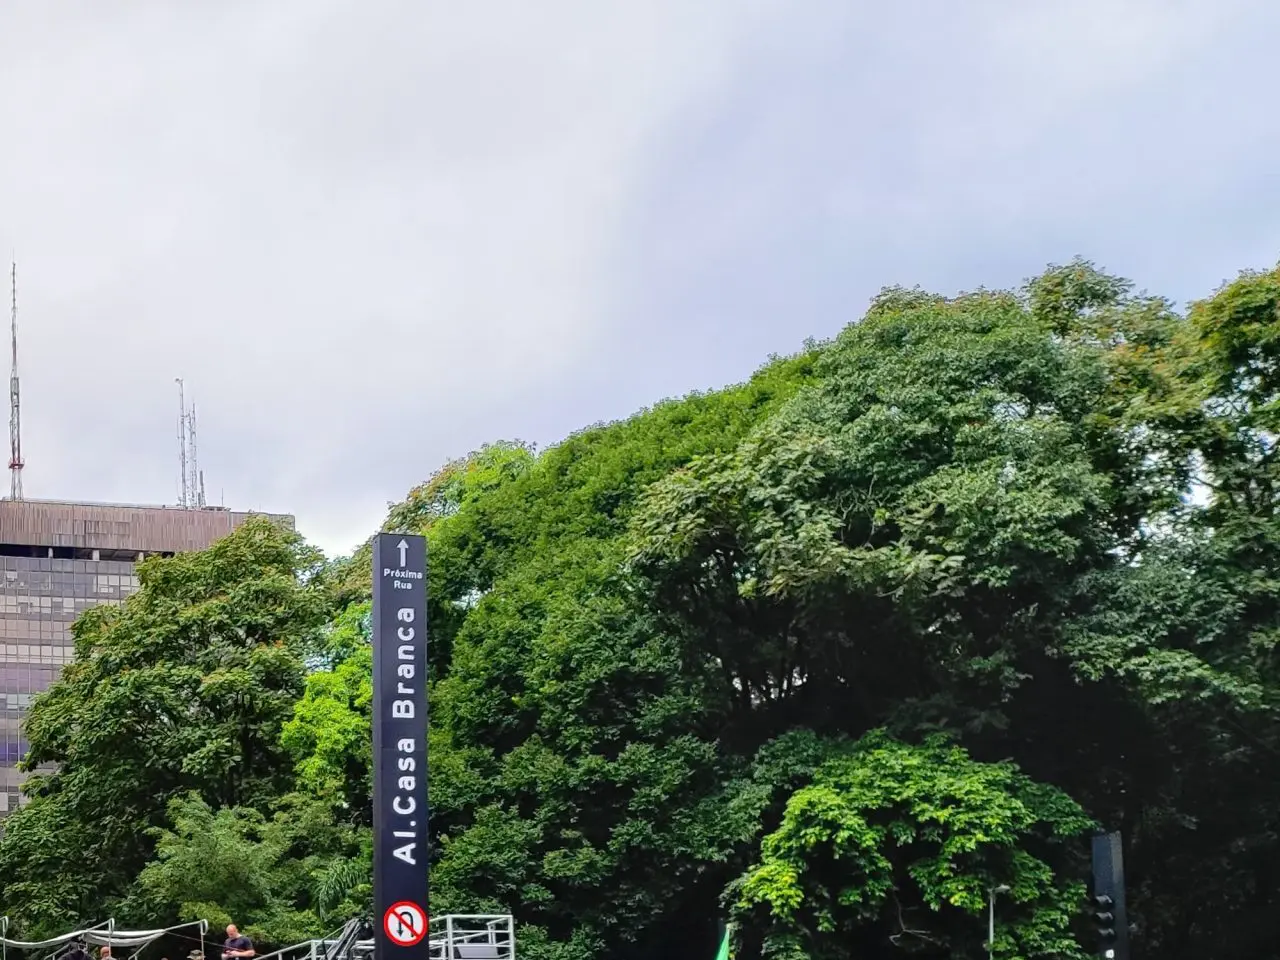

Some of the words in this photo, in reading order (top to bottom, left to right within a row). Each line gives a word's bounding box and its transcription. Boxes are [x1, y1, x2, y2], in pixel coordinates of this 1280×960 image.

[383, 568, 423, 580] Próxima
[393, 580, 413, 590] Rua
[392, 607, 416, 719] Branca
